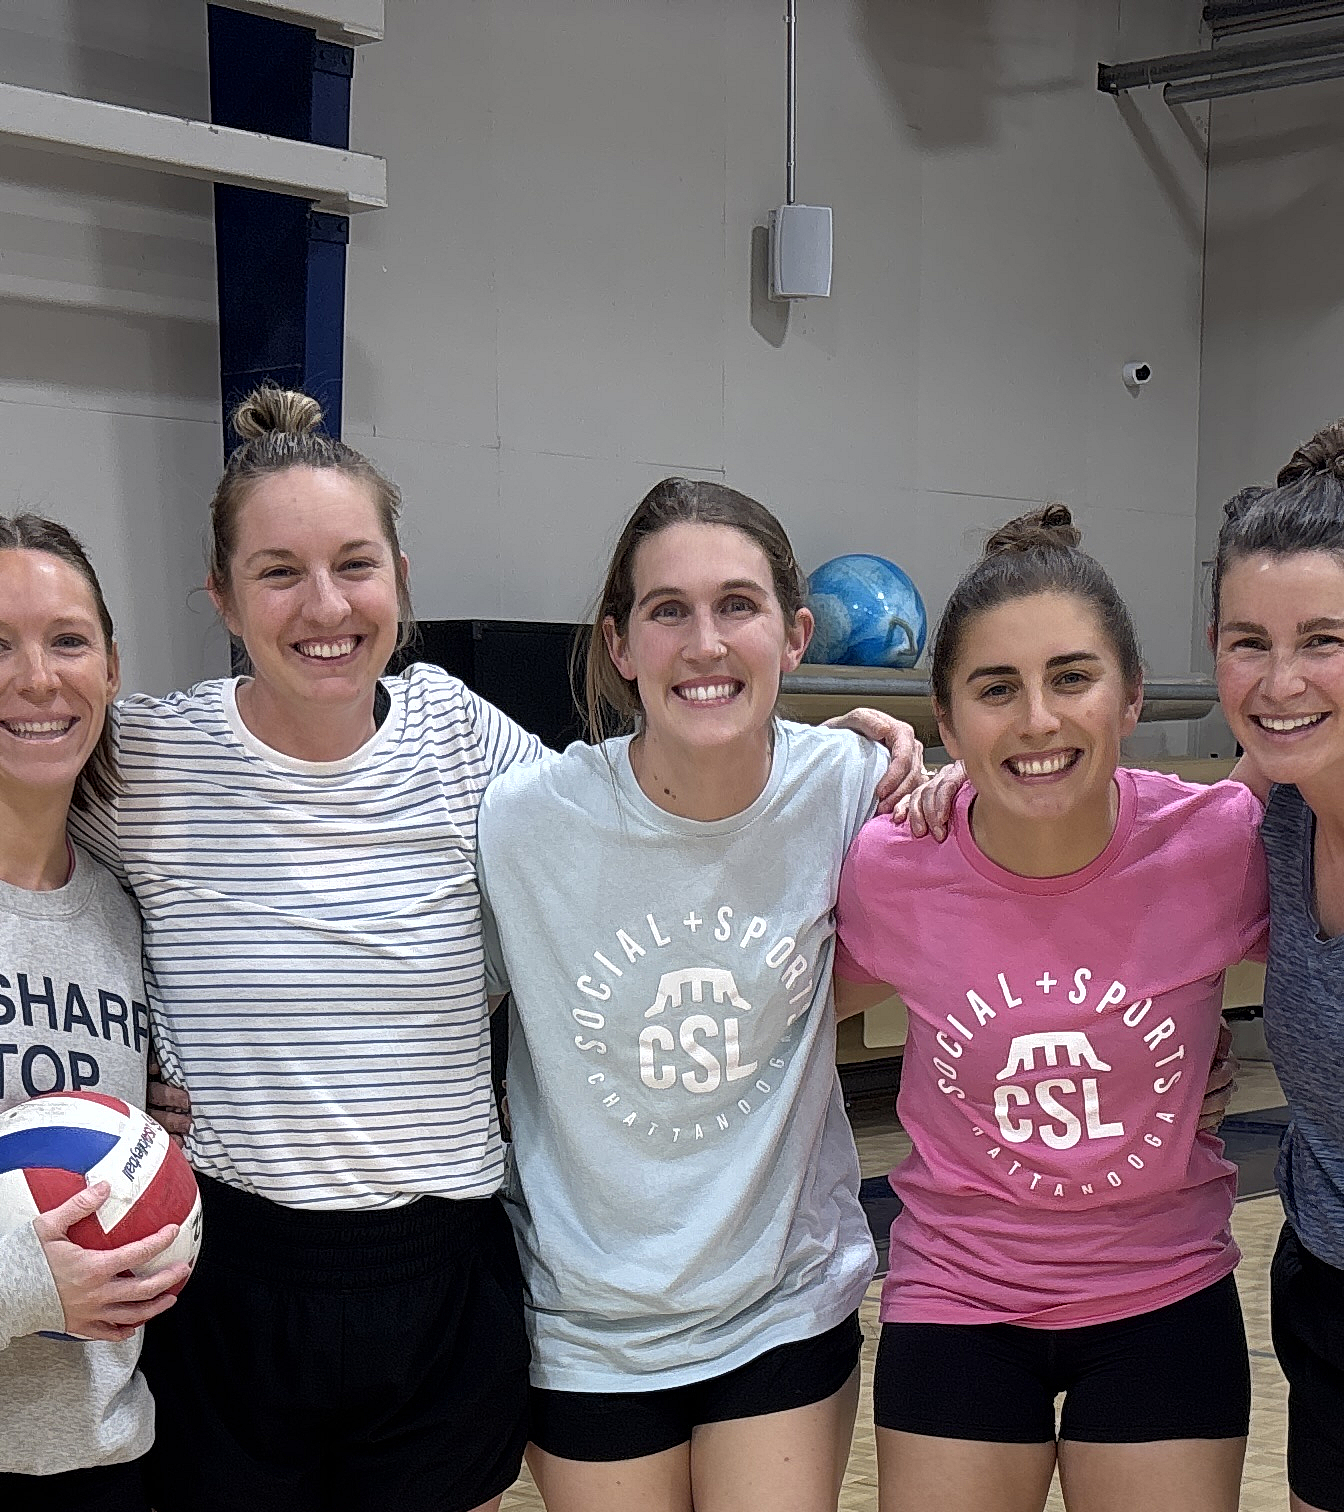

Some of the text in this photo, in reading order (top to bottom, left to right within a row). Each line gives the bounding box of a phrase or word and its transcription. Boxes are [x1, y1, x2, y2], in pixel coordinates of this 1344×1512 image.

[572, 914, 671, 1055] SOCIAL
[933, 972, 1023, 1099] SOCIAL
[1068, 967, 1185, 1095] SPORTS
[588, 1034, 791, 1142] CHATTANOOG
[639, 1015, 758, 1093] CSL
[972, 1111, 1175, 1197] HATTANOOGA
[994, 1078, 1124, 1150] CSL
